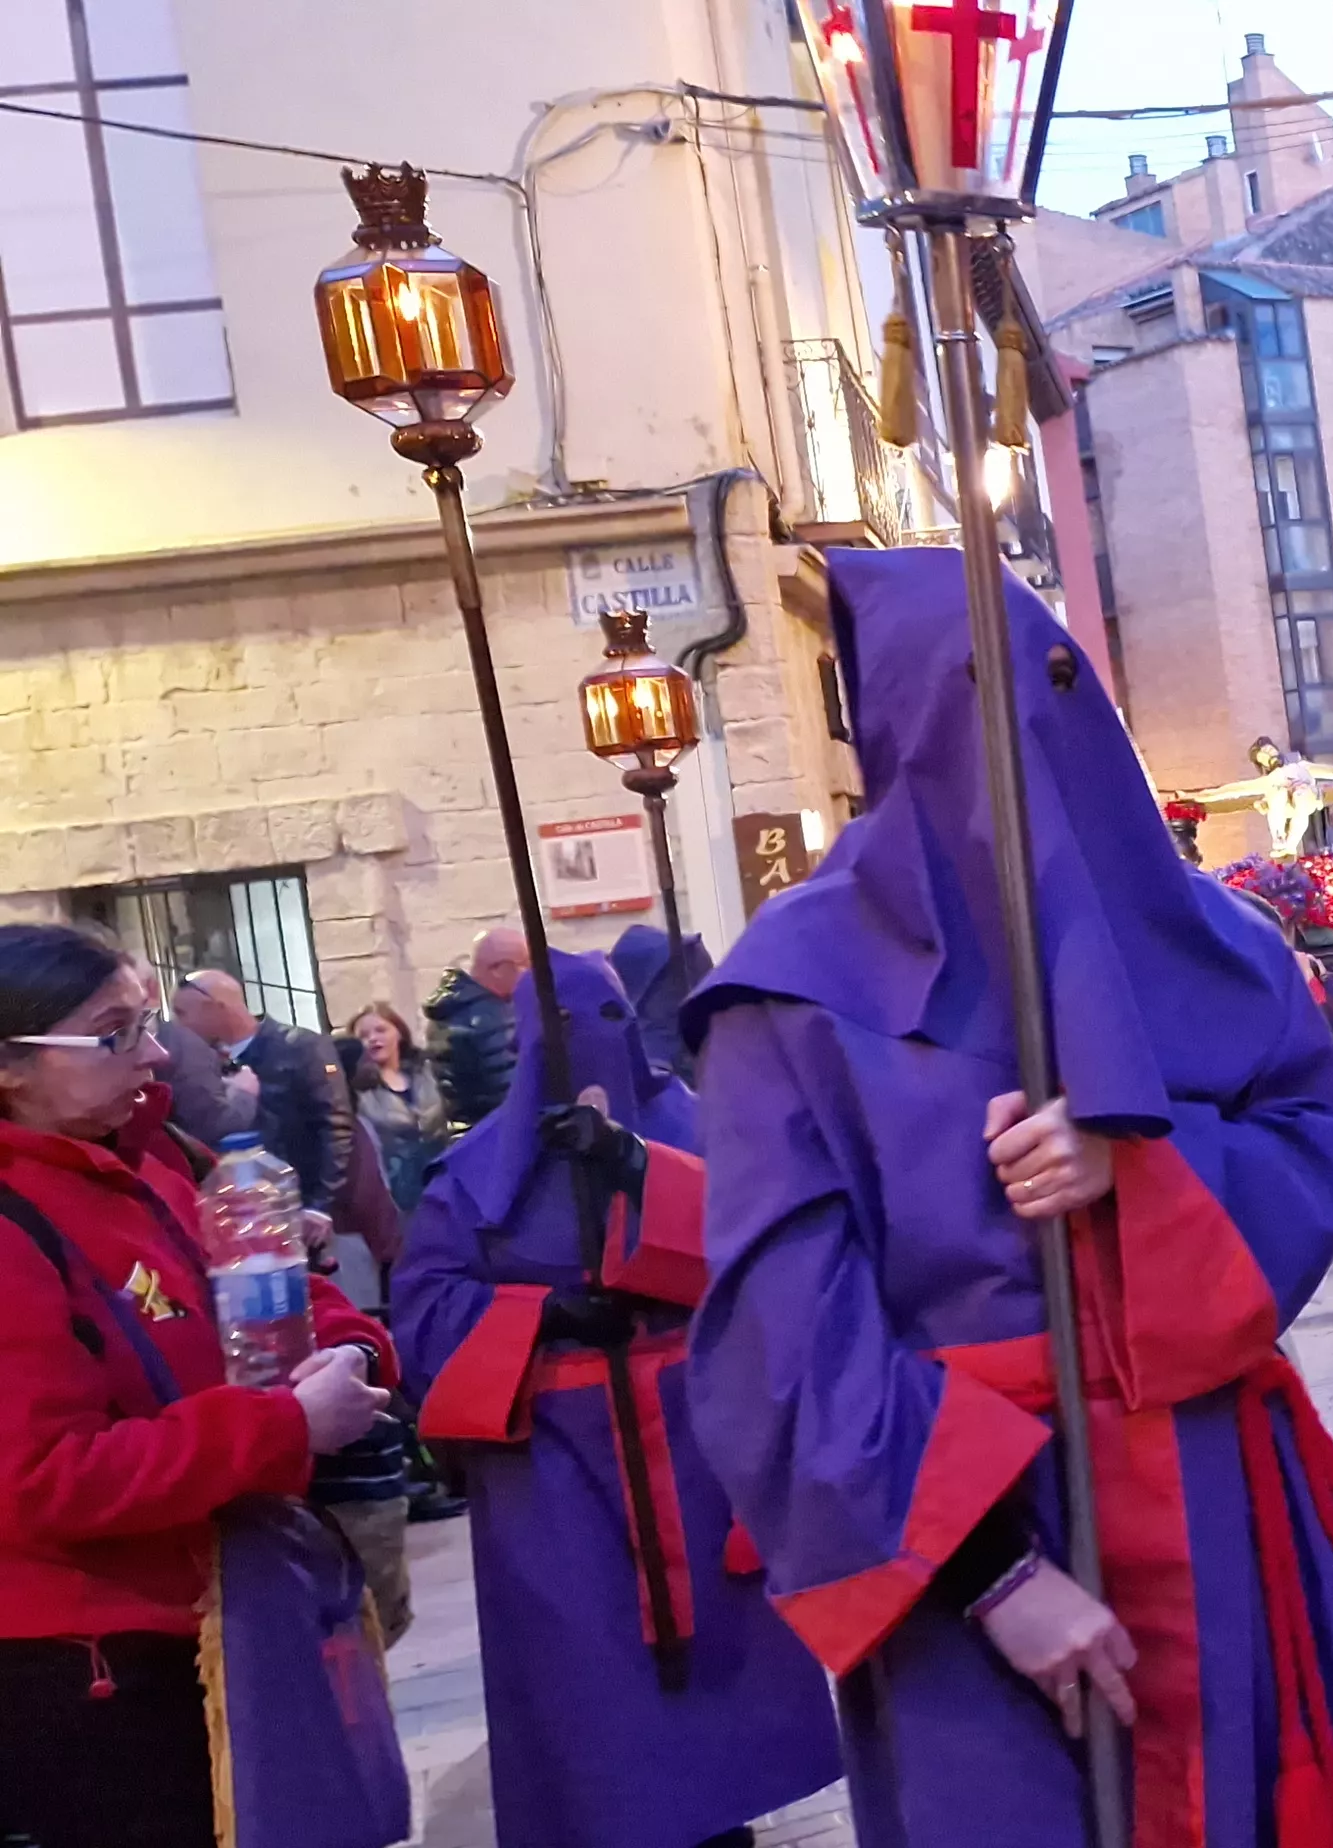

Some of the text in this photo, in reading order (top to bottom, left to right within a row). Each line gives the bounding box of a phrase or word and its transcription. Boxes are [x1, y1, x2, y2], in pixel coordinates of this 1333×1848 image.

[613, 553, 675, 574] CALLE
[581, 583, 694, 615] CASTILLA
[755, 827, 792, 899] BA
